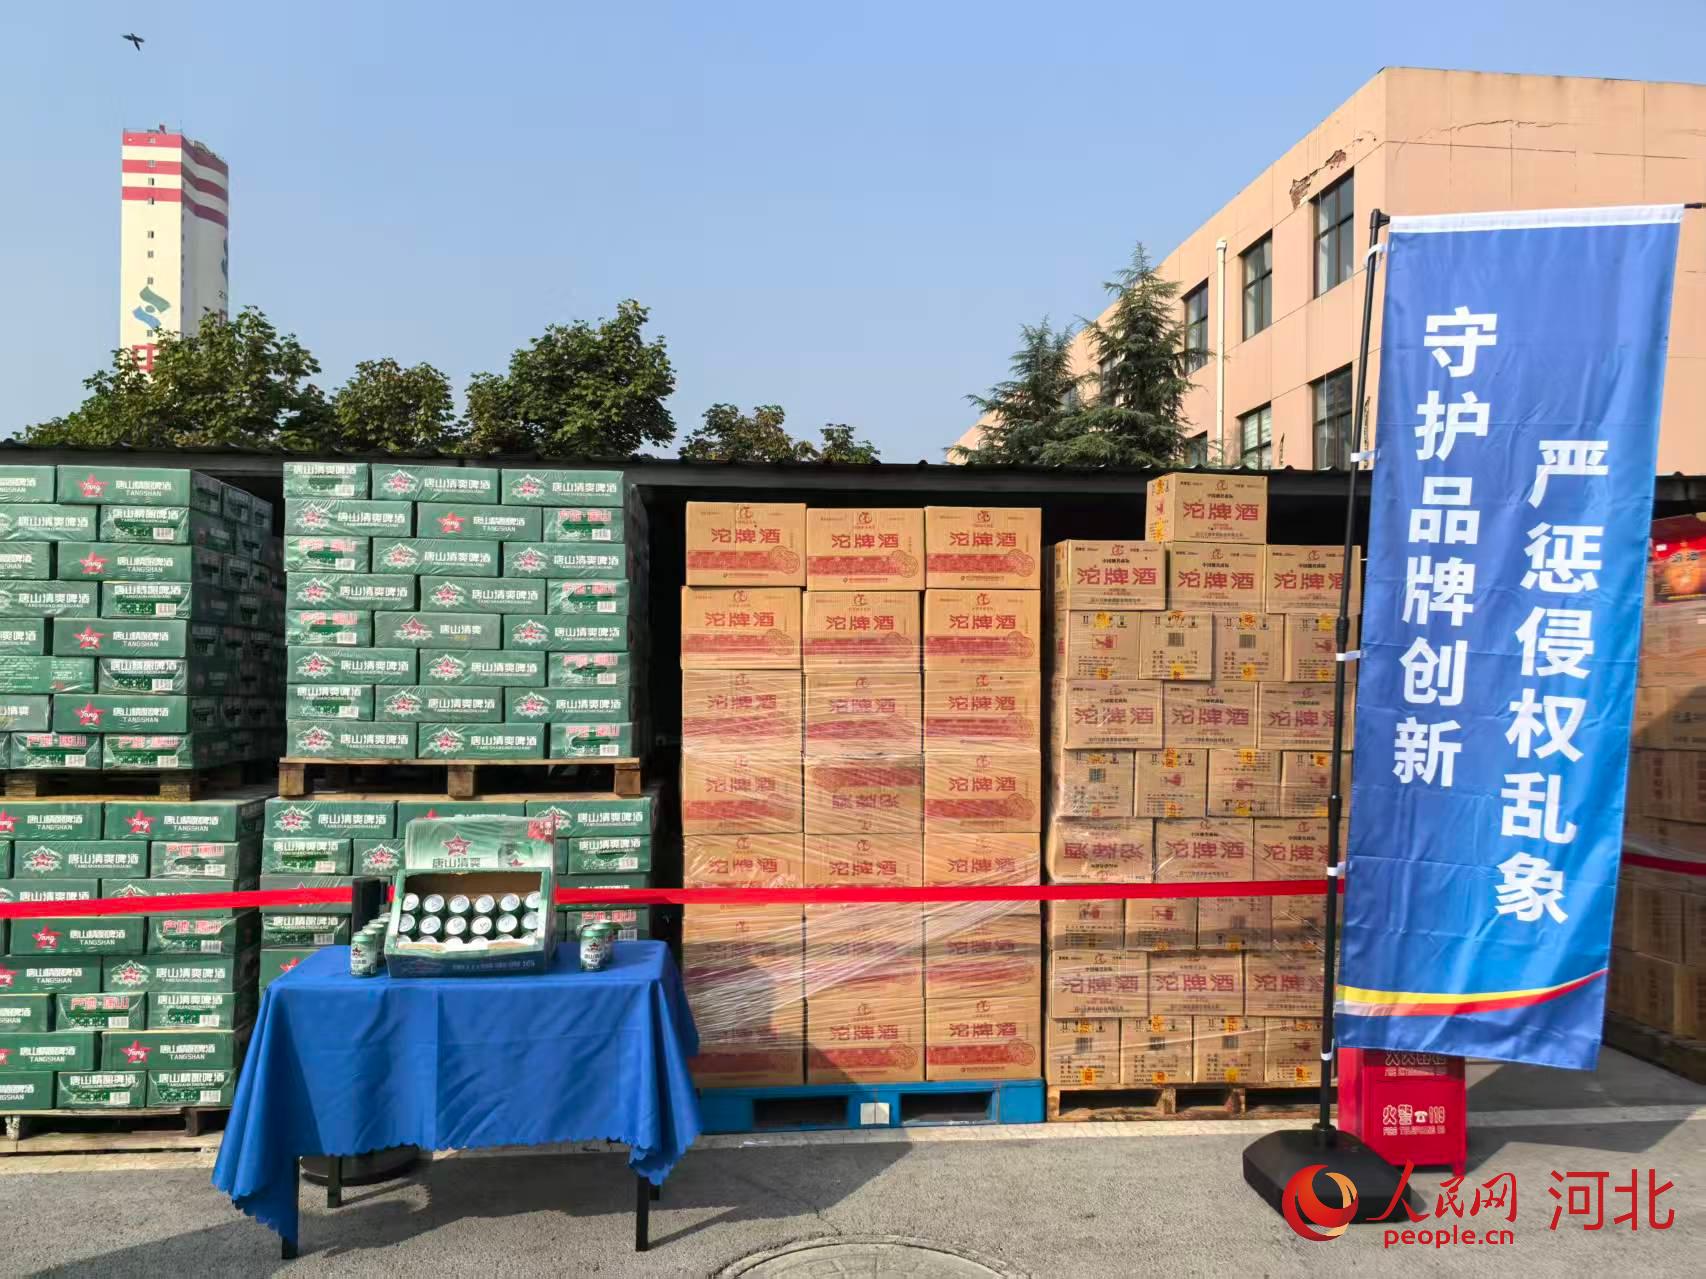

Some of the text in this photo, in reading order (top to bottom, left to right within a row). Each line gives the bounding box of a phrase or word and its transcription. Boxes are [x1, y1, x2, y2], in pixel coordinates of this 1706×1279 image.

[294, 464, 356, 476] 唐山清爽啤酒
[424, 478, 490, 490] 唐山清爽啤酒
[552, 482, 617, 493] 唐山清爽啤酒
[1183, 502, 1259, 521] 沱牌酒
[18, 516, 88, 528] 唐山清爽啤酒
[338, 512, 405, 524] 唐山清爽啤酒
[711, 528, 780, 544] 沱牌酒
[832, 534, 898, 548] 沱牌酒
[950, 532, 1016, 548] 沱牌酒
[1392, 305, 1499, 789] 守护品牌创新
[424, 552, 492, 563] 唐山清爽啤酒
[554, 554, 620, 566] 唐山清爽啤酒
[1077, 568, 1157, 586] 沱牌酒
[1178, 572, 1254, 590] 沱牌酒
[340, 586, 408, 598] 唐山清爽啤酒
[472, 589, 538, 600] 唐山清爽啤酒
[18, 593, 90, 604] 唐山清爽啤酒
[704, 612, 774, 627] 沱牌酒
[826, 616, 894, 630] 沱牌酒
[949, 614, 1016, 630] 沱牌酒
[554, 626, 620, 638] 唐山清爽啤酒
[340, 660, 409, 672] 唐山清爽啤酒
[472, 662, 538, 674] 唐山清爽啤酒
[1495, 439, 1610, 925] 严惩侵权乱象
[296, 687, 361, 698] 唐山清爽啤酒
[428, 698, 496, 710] 唐山清爽啤酒
[556, 699, 622, 710] 唐山清爽啤酒
[1074, 707, 1153, 725] 沱牌酒
[1172, 708, 1249, 726] 沱牌酒
[340, 734, 408, 746] 唐山清爽啤酒
[471, 736, 537, 747] 唐山清爽啤酒
[318, 814, 387, 825] 唐山清爽啤酒
[577, 812, 643, 823] 唐山清爽啤酒
[1166, 841, 1244, 860] 沱牌酒
[68, 854, 140, 864] 唐山清爽啤酒
[156, 968, 226, 978] 唐山清爽啤酒
[1156, 974, 1234, 992] 沱牌酒
[158, 995, 222, 1006] 唐山清爽啤酒
[830, 1024, 898, 1040] 沱牌酒
[949, 1023, 1016, 1038] 沱牌酒
